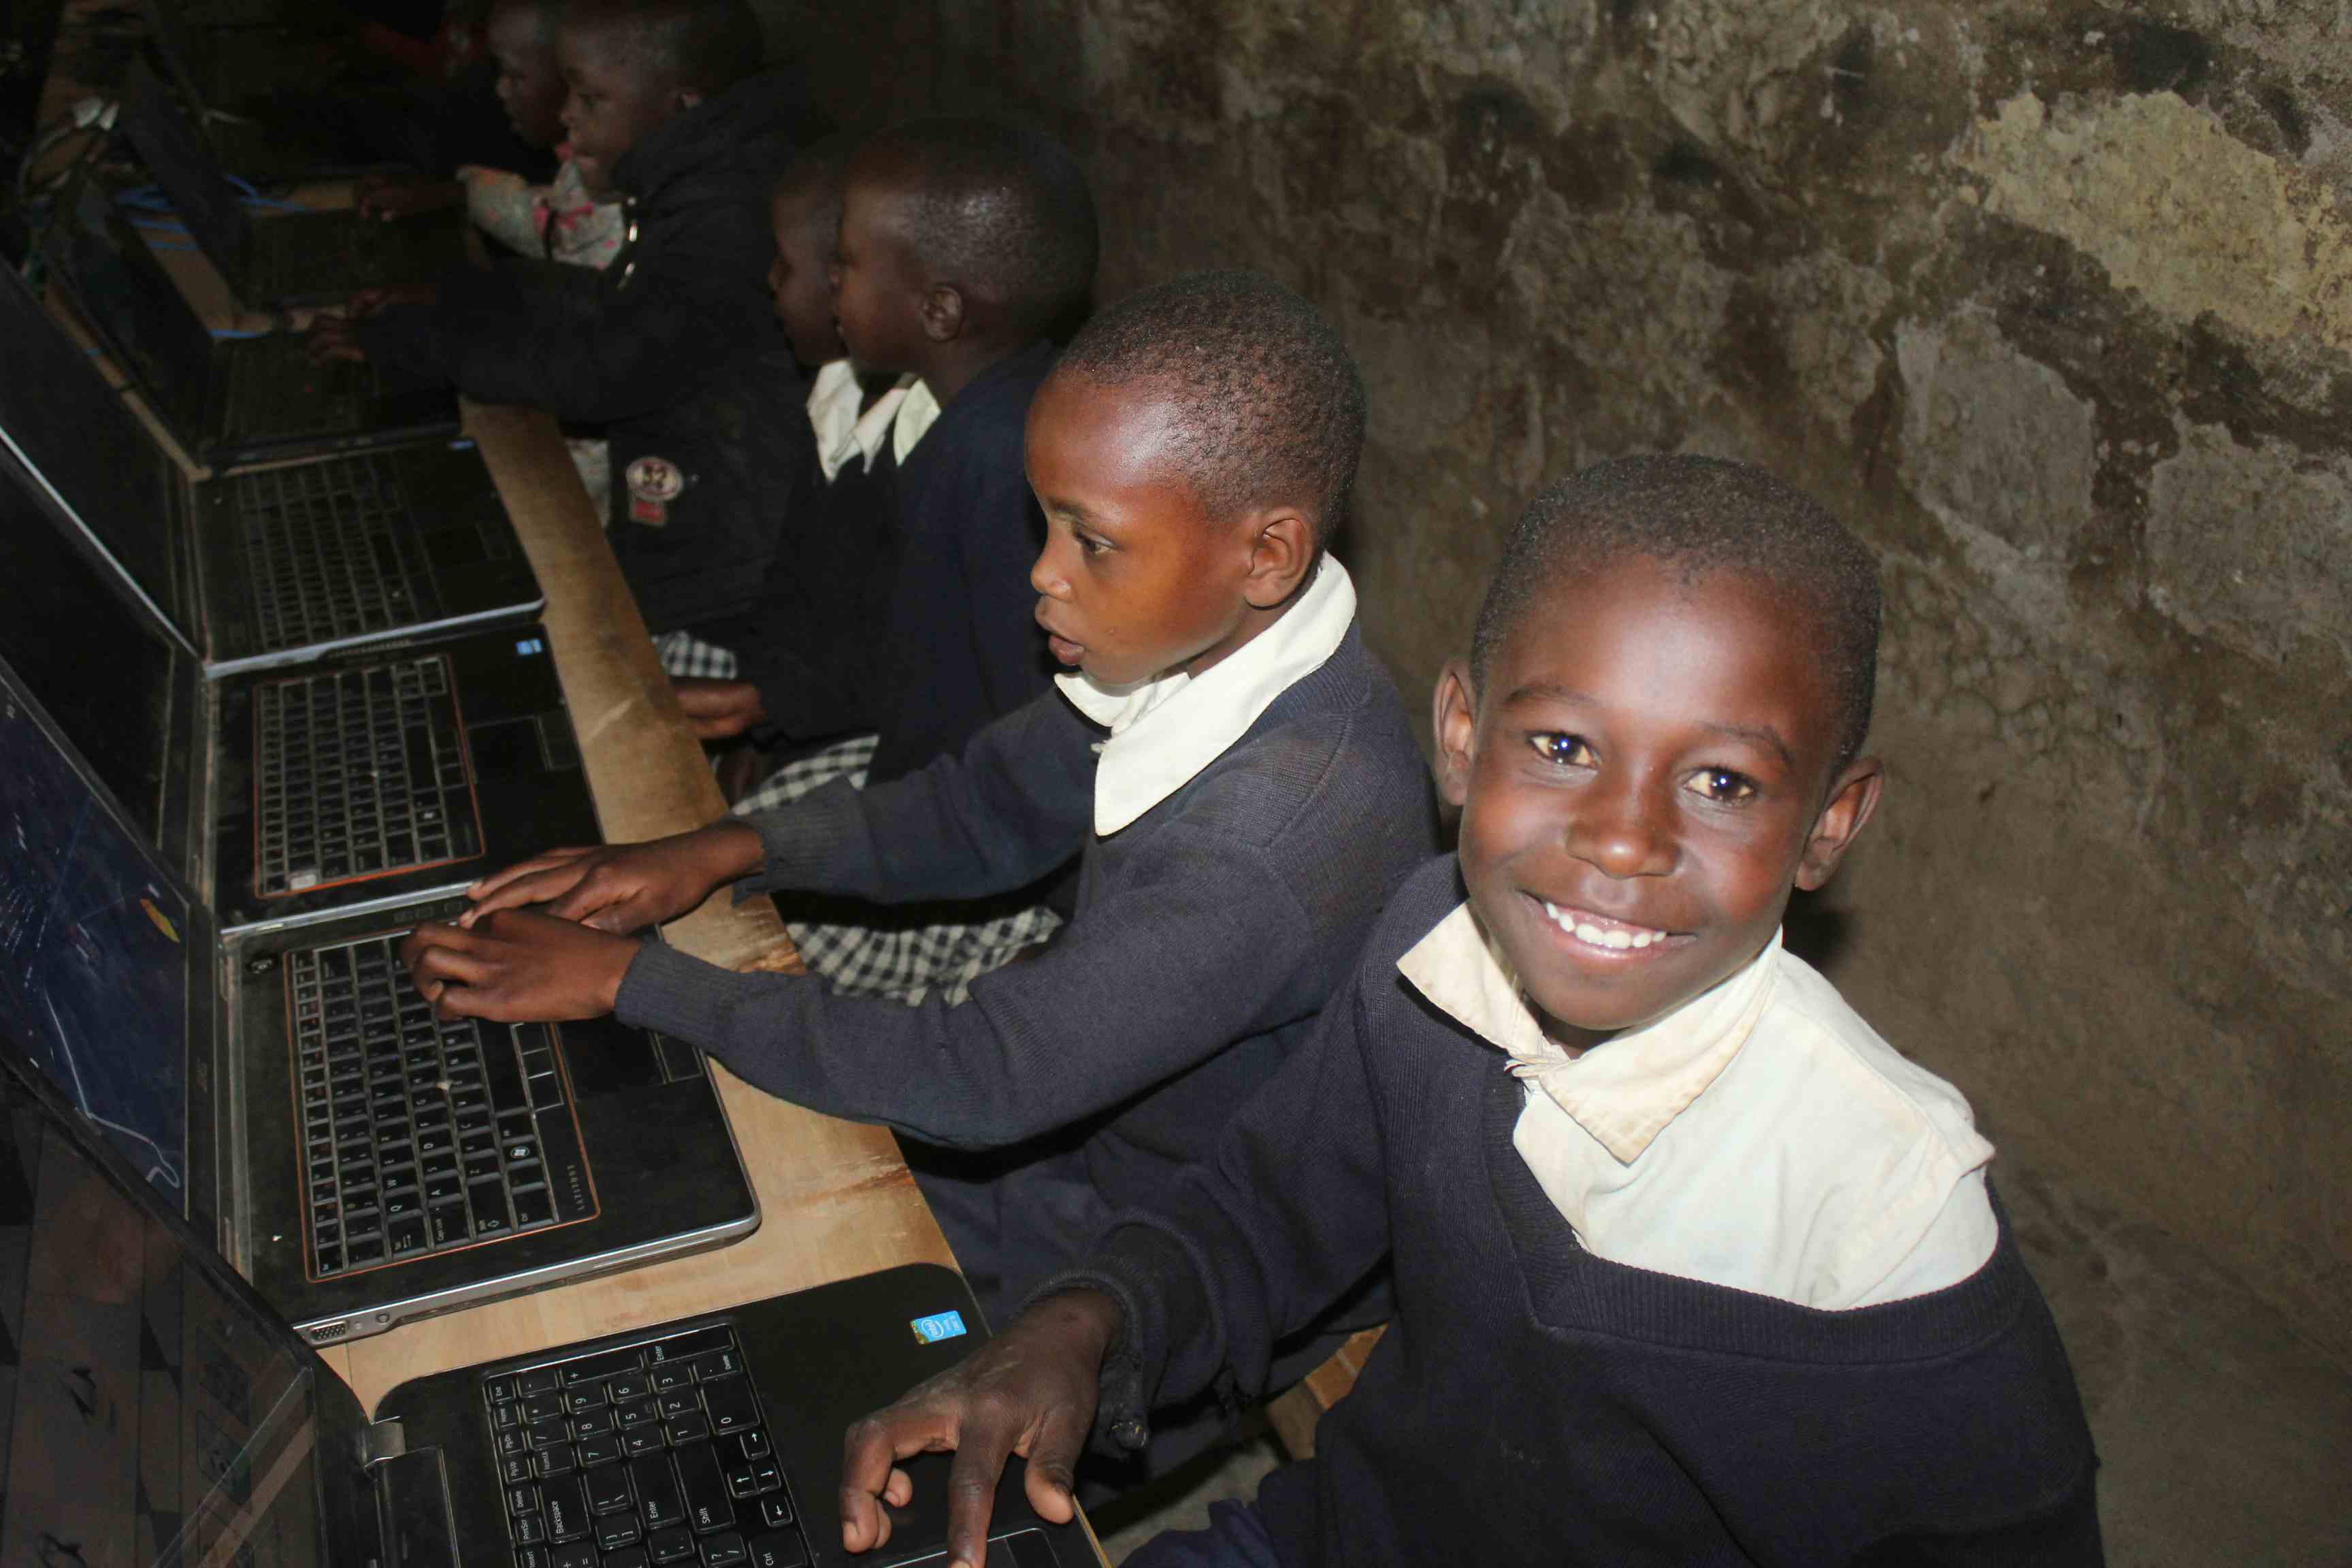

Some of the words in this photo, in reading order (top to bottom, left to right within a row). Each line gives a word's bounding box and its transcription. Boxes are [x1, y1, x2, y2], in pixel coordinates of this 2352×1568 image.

[390, 1204, 403, 1212] Q
[655, 1345, 665, 1361] Enter
[504, 1433, 513, 1449] PgDn
[551, 1500, 564, 1534] Backspace
[648, 1500, 659, 1519] Enter
[698, 1507, 710, 1524] Shift
[763, 1552, 774, 1567] Ctrl
